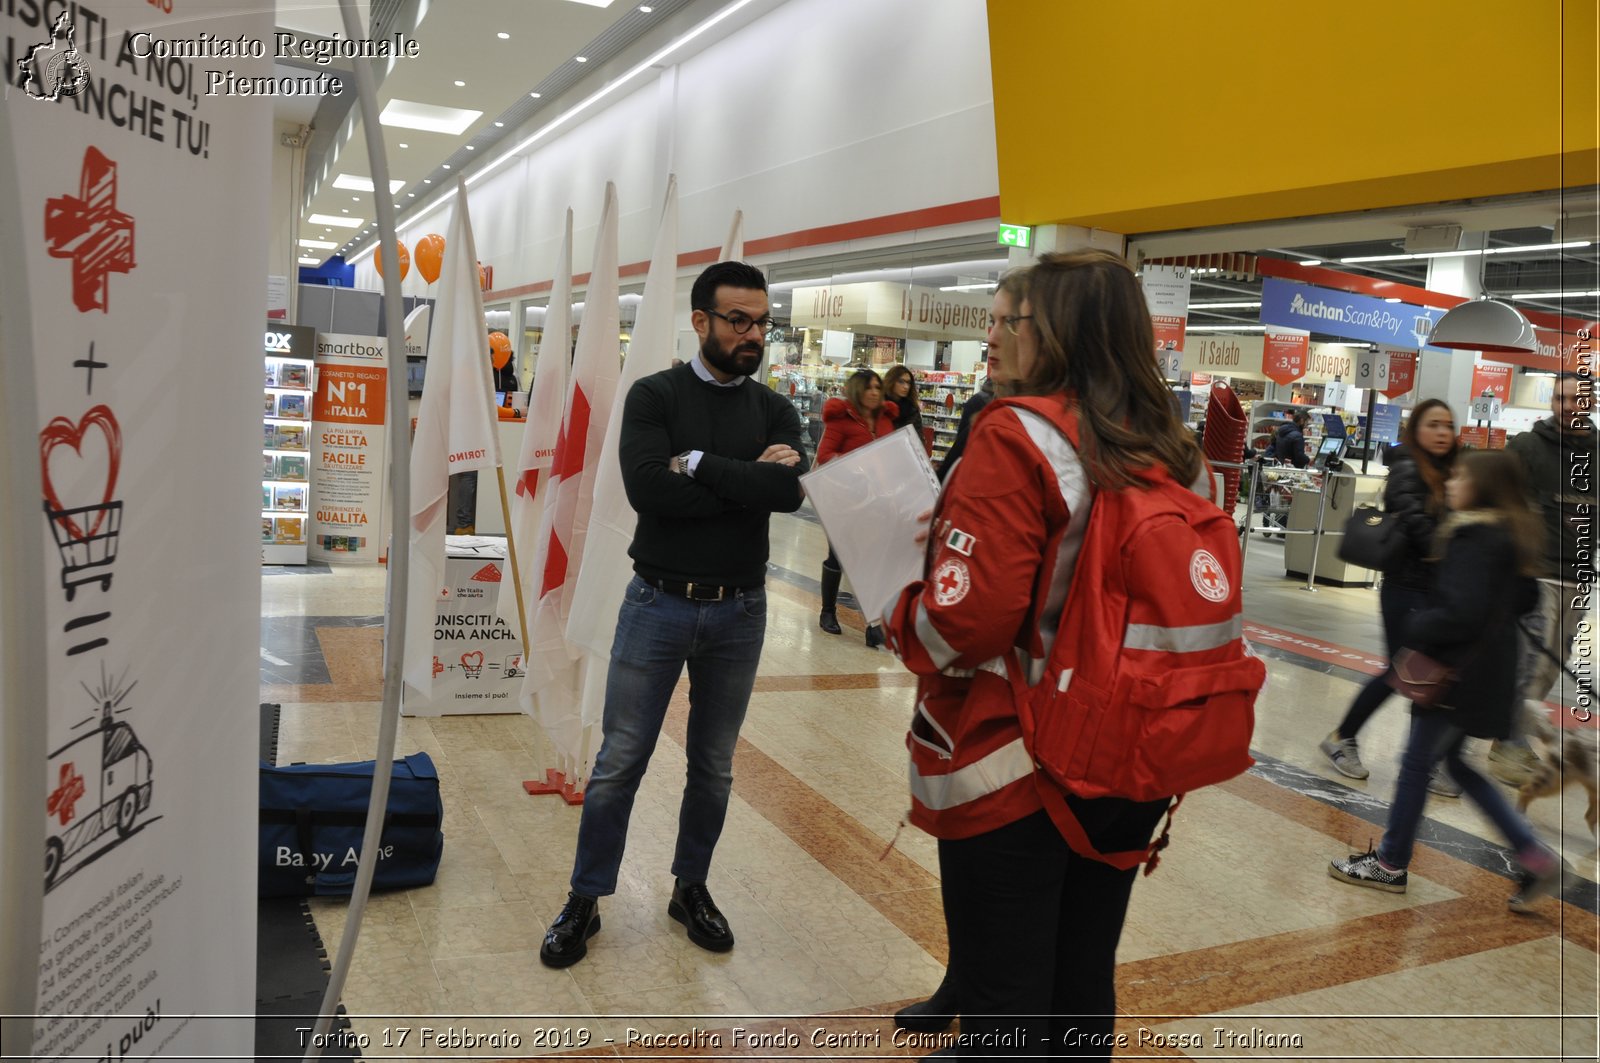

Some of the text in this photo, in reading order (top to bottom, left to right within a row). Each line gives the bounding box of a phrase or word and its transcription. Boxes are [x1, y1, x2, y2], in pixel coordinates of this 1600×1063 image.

[115, 30, 138, 76] A
[172, 108, 210, 159] TU!
[919, 292, 986, 330] Dispensa
[318, 343, 383, 357] smartbox
[1199, 341, 1240, 365] il Salato
[1172, 359, 1179, 371] 2
[1361, 363, 1369, 377] 3
[1379, 364, 1386, 378] 3
[327, 380, 366, 404] N°1
[1328, 388, 1334, 397] 7
[1340, 390, 1345, 398] 7
[331, 405, 367, 418] ITALIA
[1482, 403, 1488, 413] 8
[1494, 404, 1499, 414] 8
[322, 434, 368, 447] SCELTA
[322, 452, 366, 464] FACILE
[495, 617, 506, 626] A
[434, 629, 465, 640] ONA
[55, 927, 91, 967] grande
[41, 971, 54, 996] 24
[58, 940, 98, 982] febbraio
